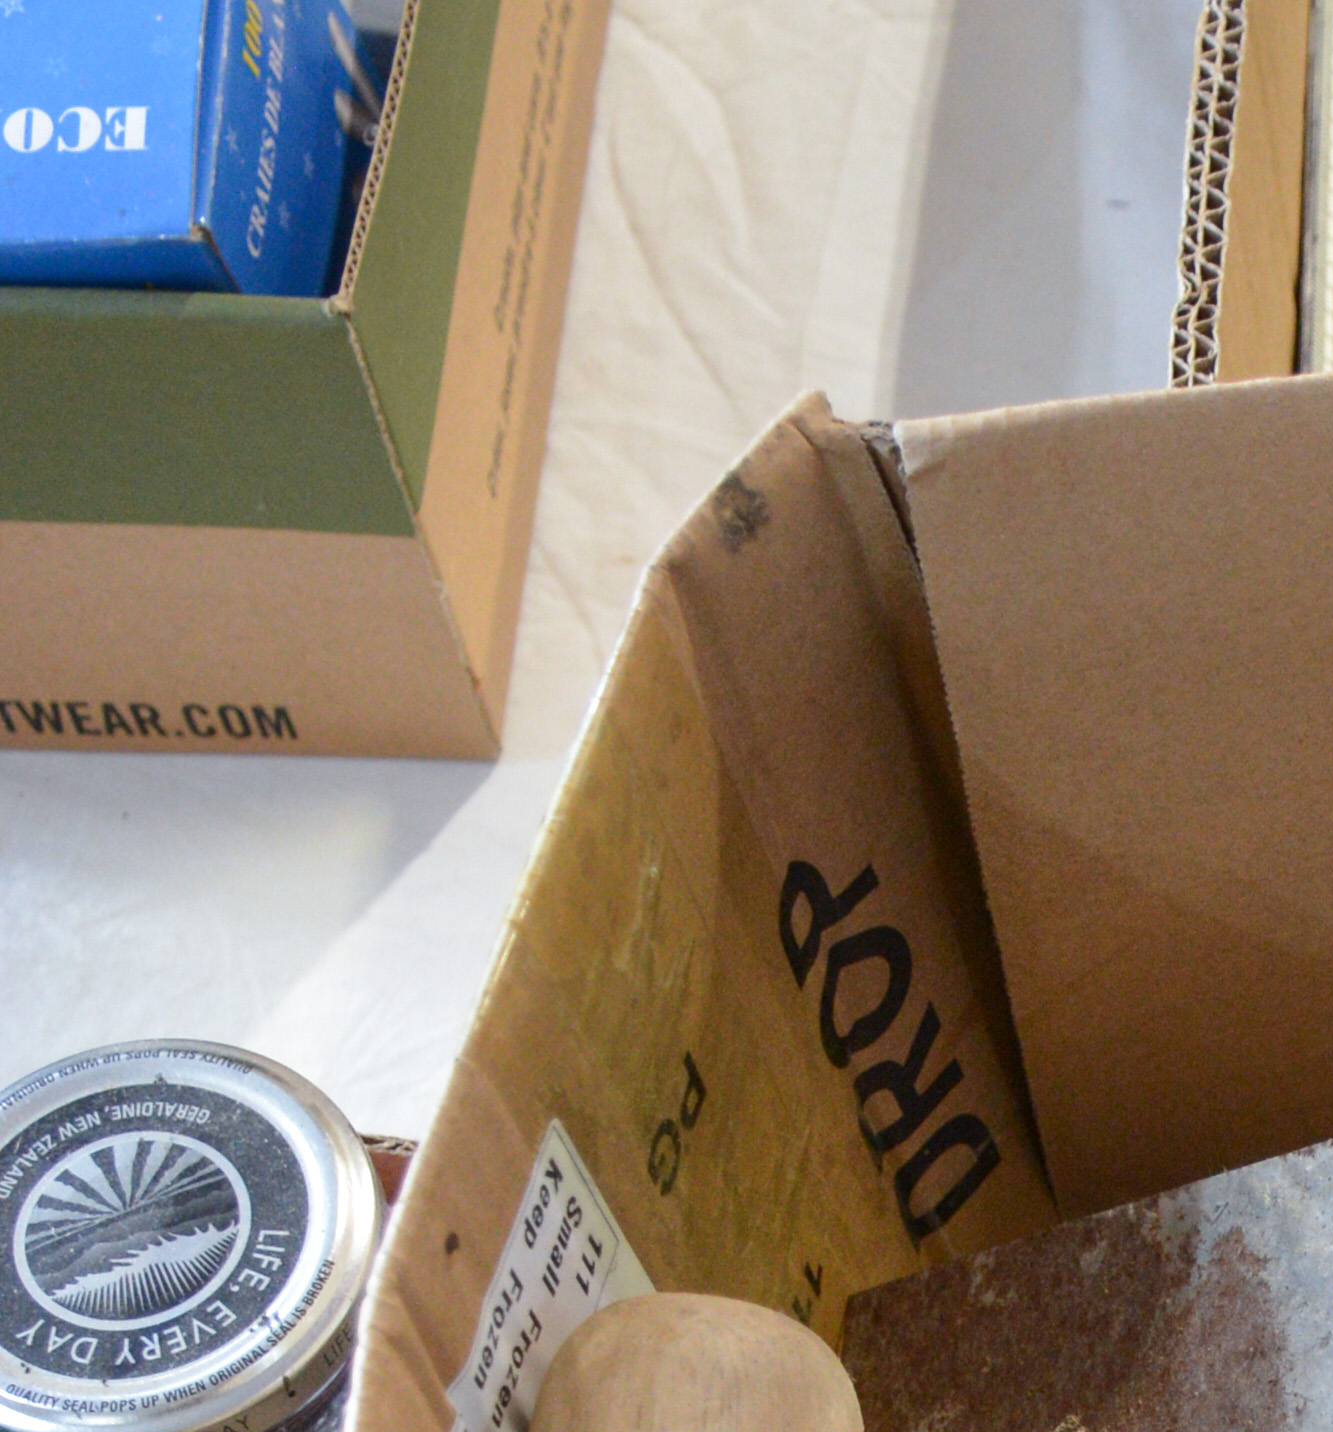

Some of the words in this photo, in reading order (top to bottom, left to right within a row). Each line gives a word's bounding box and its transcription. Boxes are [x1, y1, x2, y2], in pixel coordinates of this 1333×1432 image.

[247, 128, 276, 259] CRAIES
[264, 77, 281, 134] DE
[58, 1058, 100, 1078] WHEN
[103, 1053, 121, 1064] UP
[126, 1050, 160, 1060] POPS
[167, 1049, 196, 1060] SEAL
[779, 860, 1000, 1253] DROP
[58, 1111, 101, 1142] NEW
[104, 1101, 211, 1124] GERALDINE,
[0, 1139, 57, 1199] ZEALAND
[523, 1158, 564, 1251] Keep
[228, 1229, 290, 1292] LIFE,
[541, 1195, 583, 1299] Small
[575, 1233, 603, 1297] 111
[6, 1382, 59, 1408] QUALITY
[61, 1397, 98, 1413] SEAL
[101, 1399, 137, 1413] POPS
[141, 1395, 160, 1409] UP
[163, 1380, 207, 1403] WHEN
[208, 1349, 269, 1387] ORIGINAL
[267, 1321, 296, 1353] SEAL
[292, 1306, 307, 1321] IS
[305, 1259, 336, 1306] BROKEN
[15, 1318, 99, 1365] DAY
[114, 1300, 238, 1366] EVERY
[473, 1267, 524, 1391] Frozen
[492, 1308, 543, 1430] Frozen
